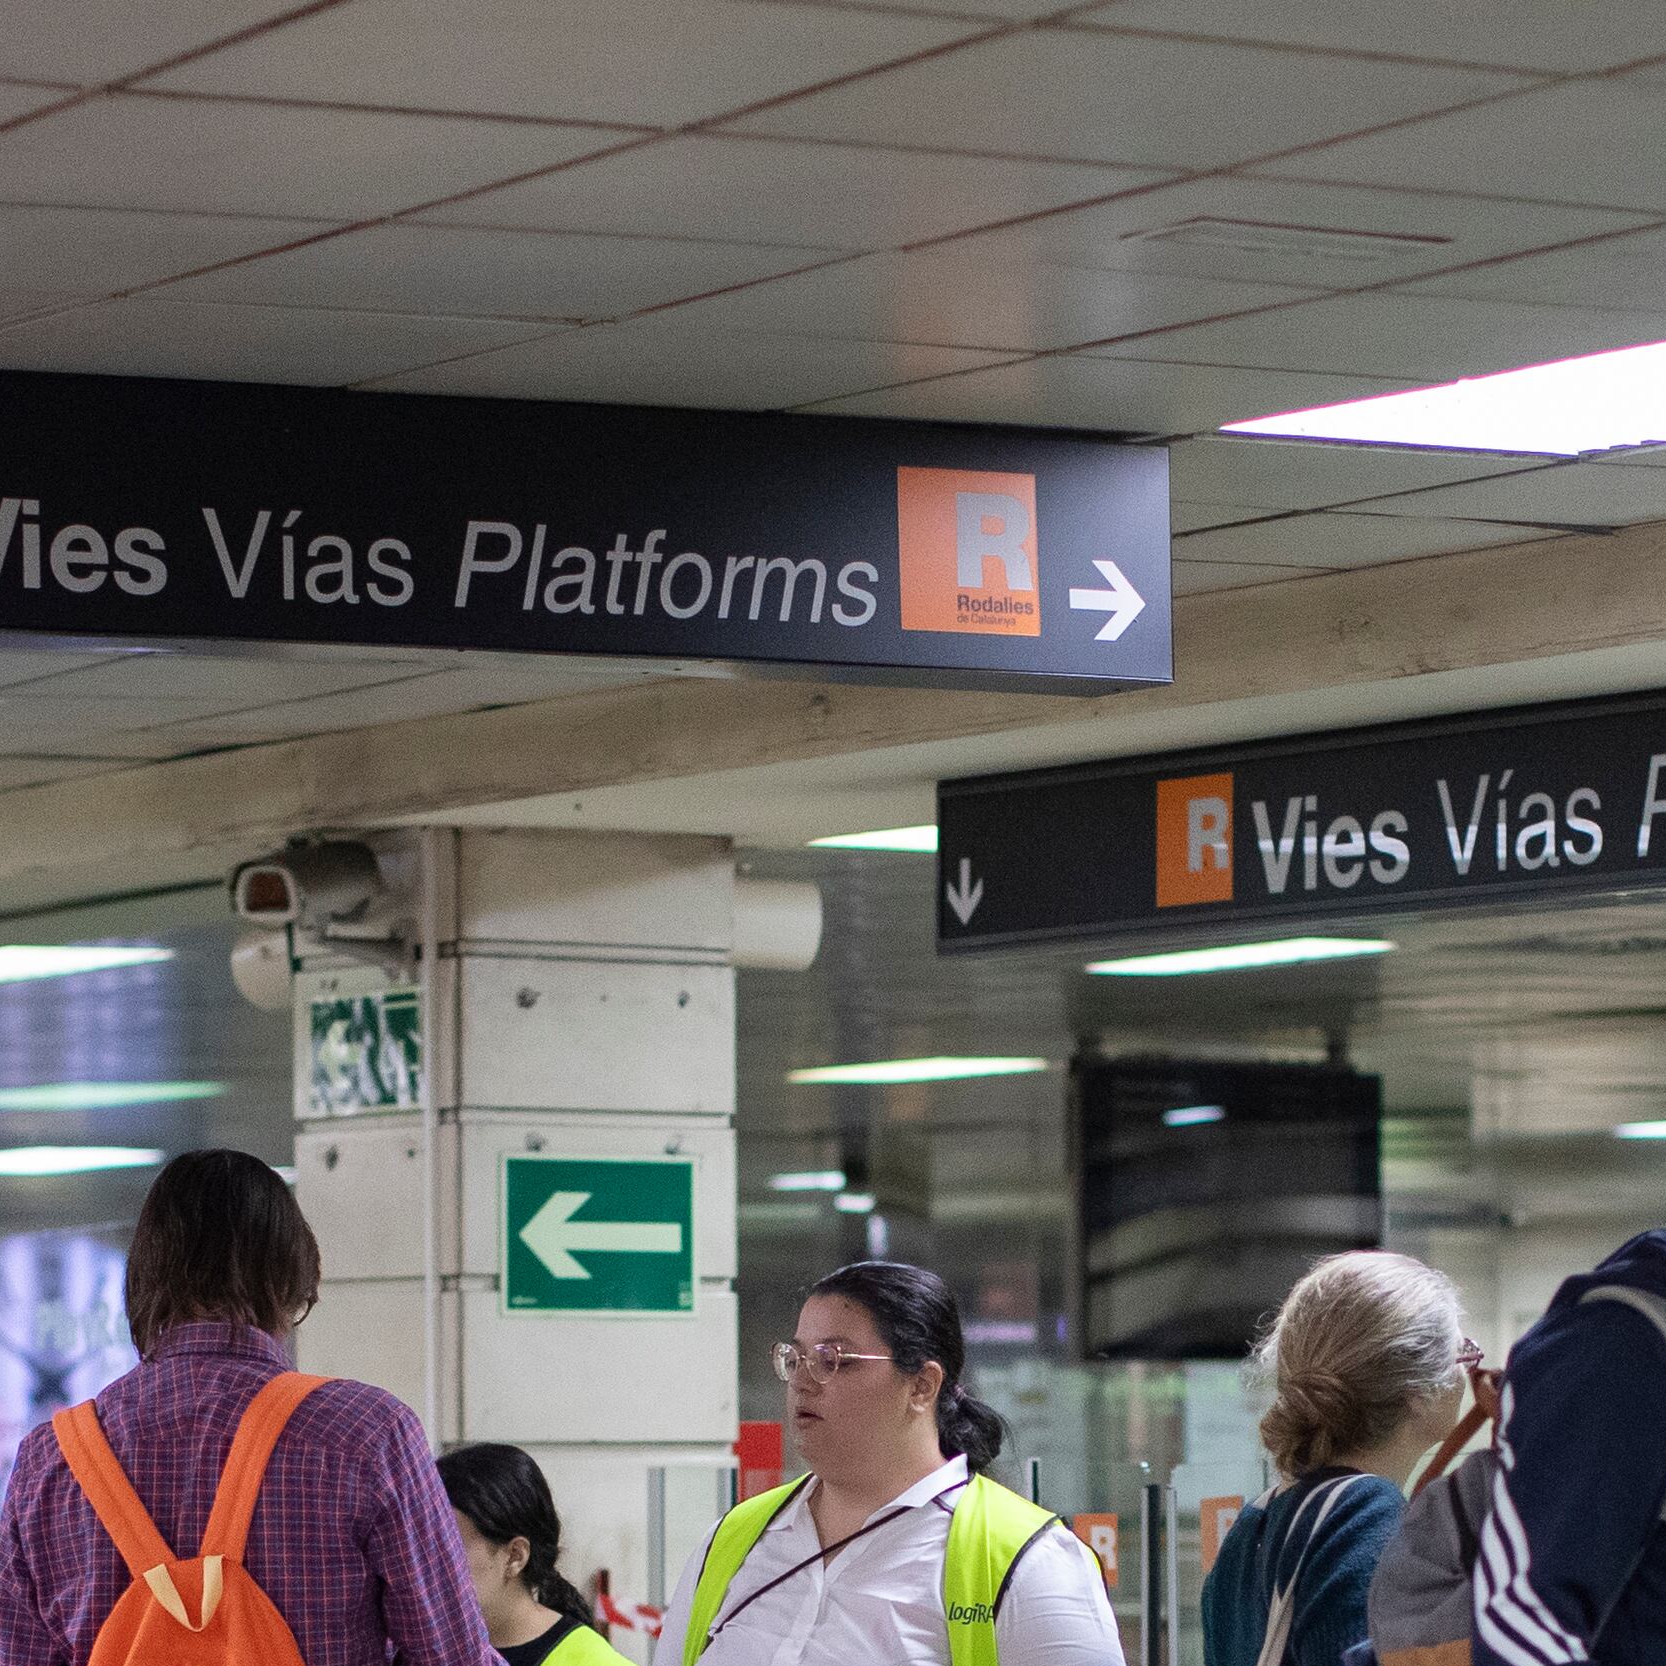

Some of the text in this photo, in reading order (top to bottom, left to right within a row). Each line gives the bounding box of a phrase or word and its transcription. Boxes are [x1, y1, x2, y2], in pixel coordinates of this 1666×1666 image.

[202, 507, 415, 607] Vías
[454, 520, 880, 627] Platforms
[956, 491, 1033, 591] R
[956, 594, 1034, 615] Rodalies
[957, 614, 1016, 627] de Catalunya
[1186, 796, 1229, 872] R
[1251, 794, 1411, 894] Vies
[1437, 768, 1603, 875] Vías
[948, 1601, 994, 1625] logiRA
